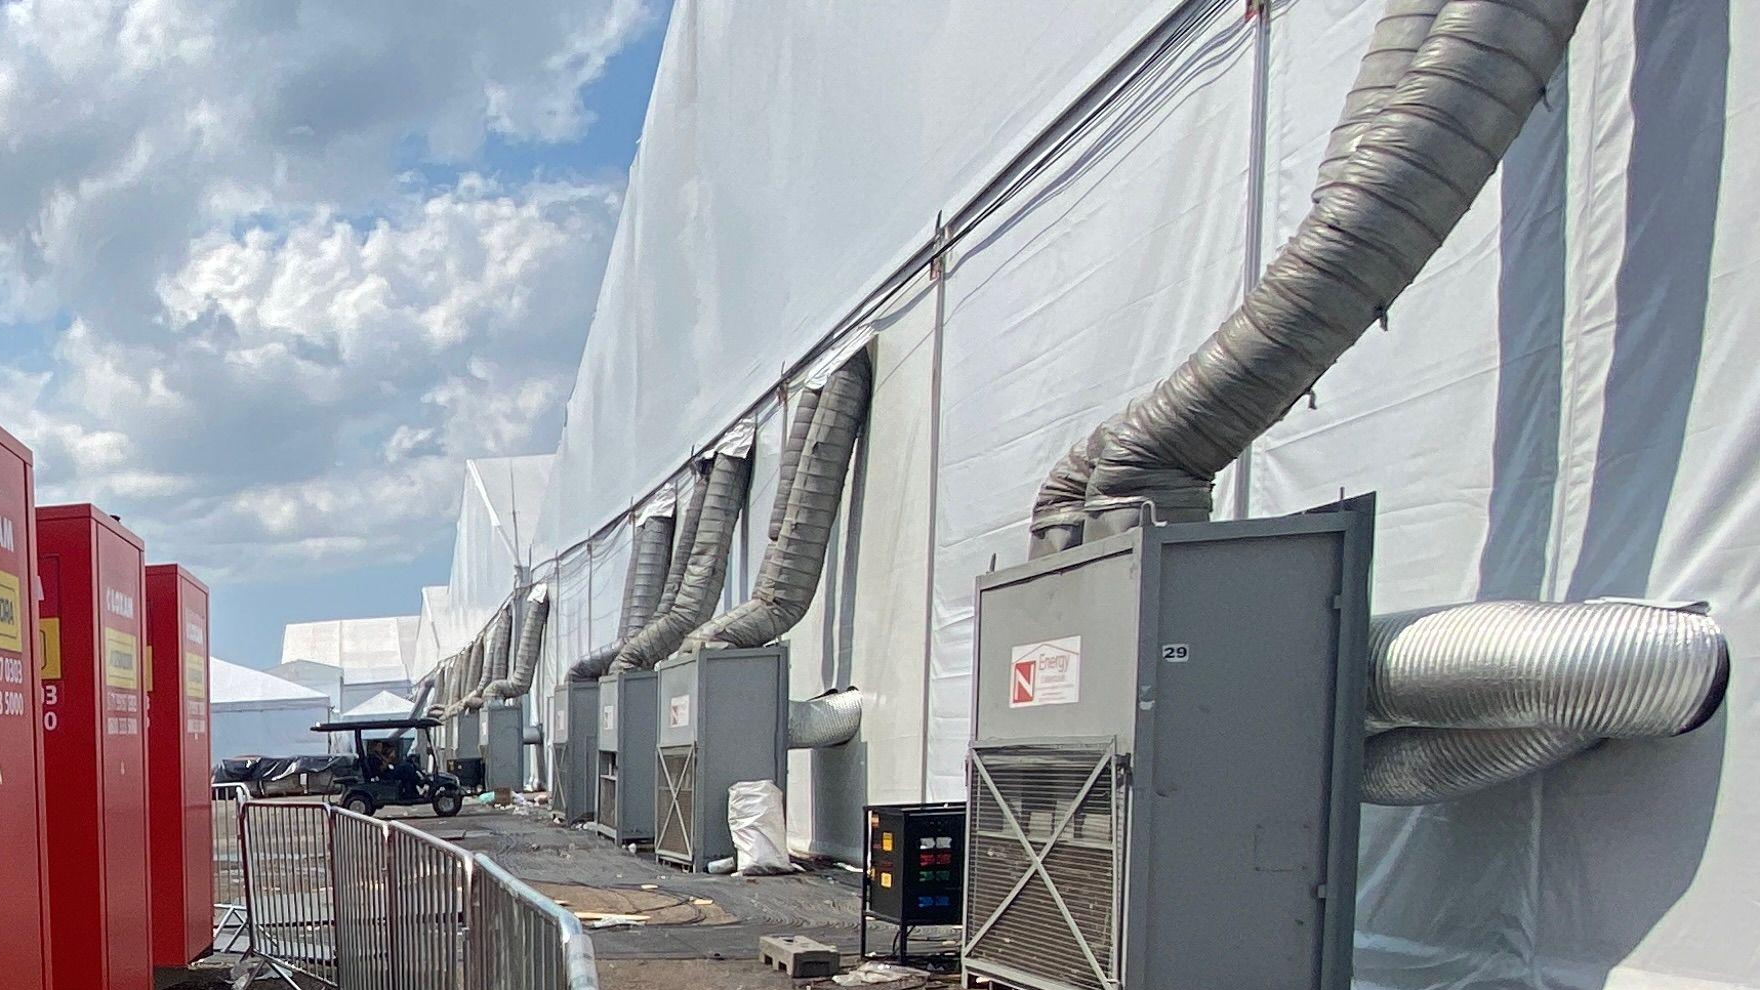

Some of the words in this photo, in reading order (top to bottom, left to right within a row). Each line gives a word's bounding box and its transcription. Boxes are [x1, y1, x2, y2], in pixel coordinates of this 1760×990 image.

[1163, 646, 1188, 659] 29
[4, 657, 23, 684] 0303
[4, 691, 24, 716] 5000
